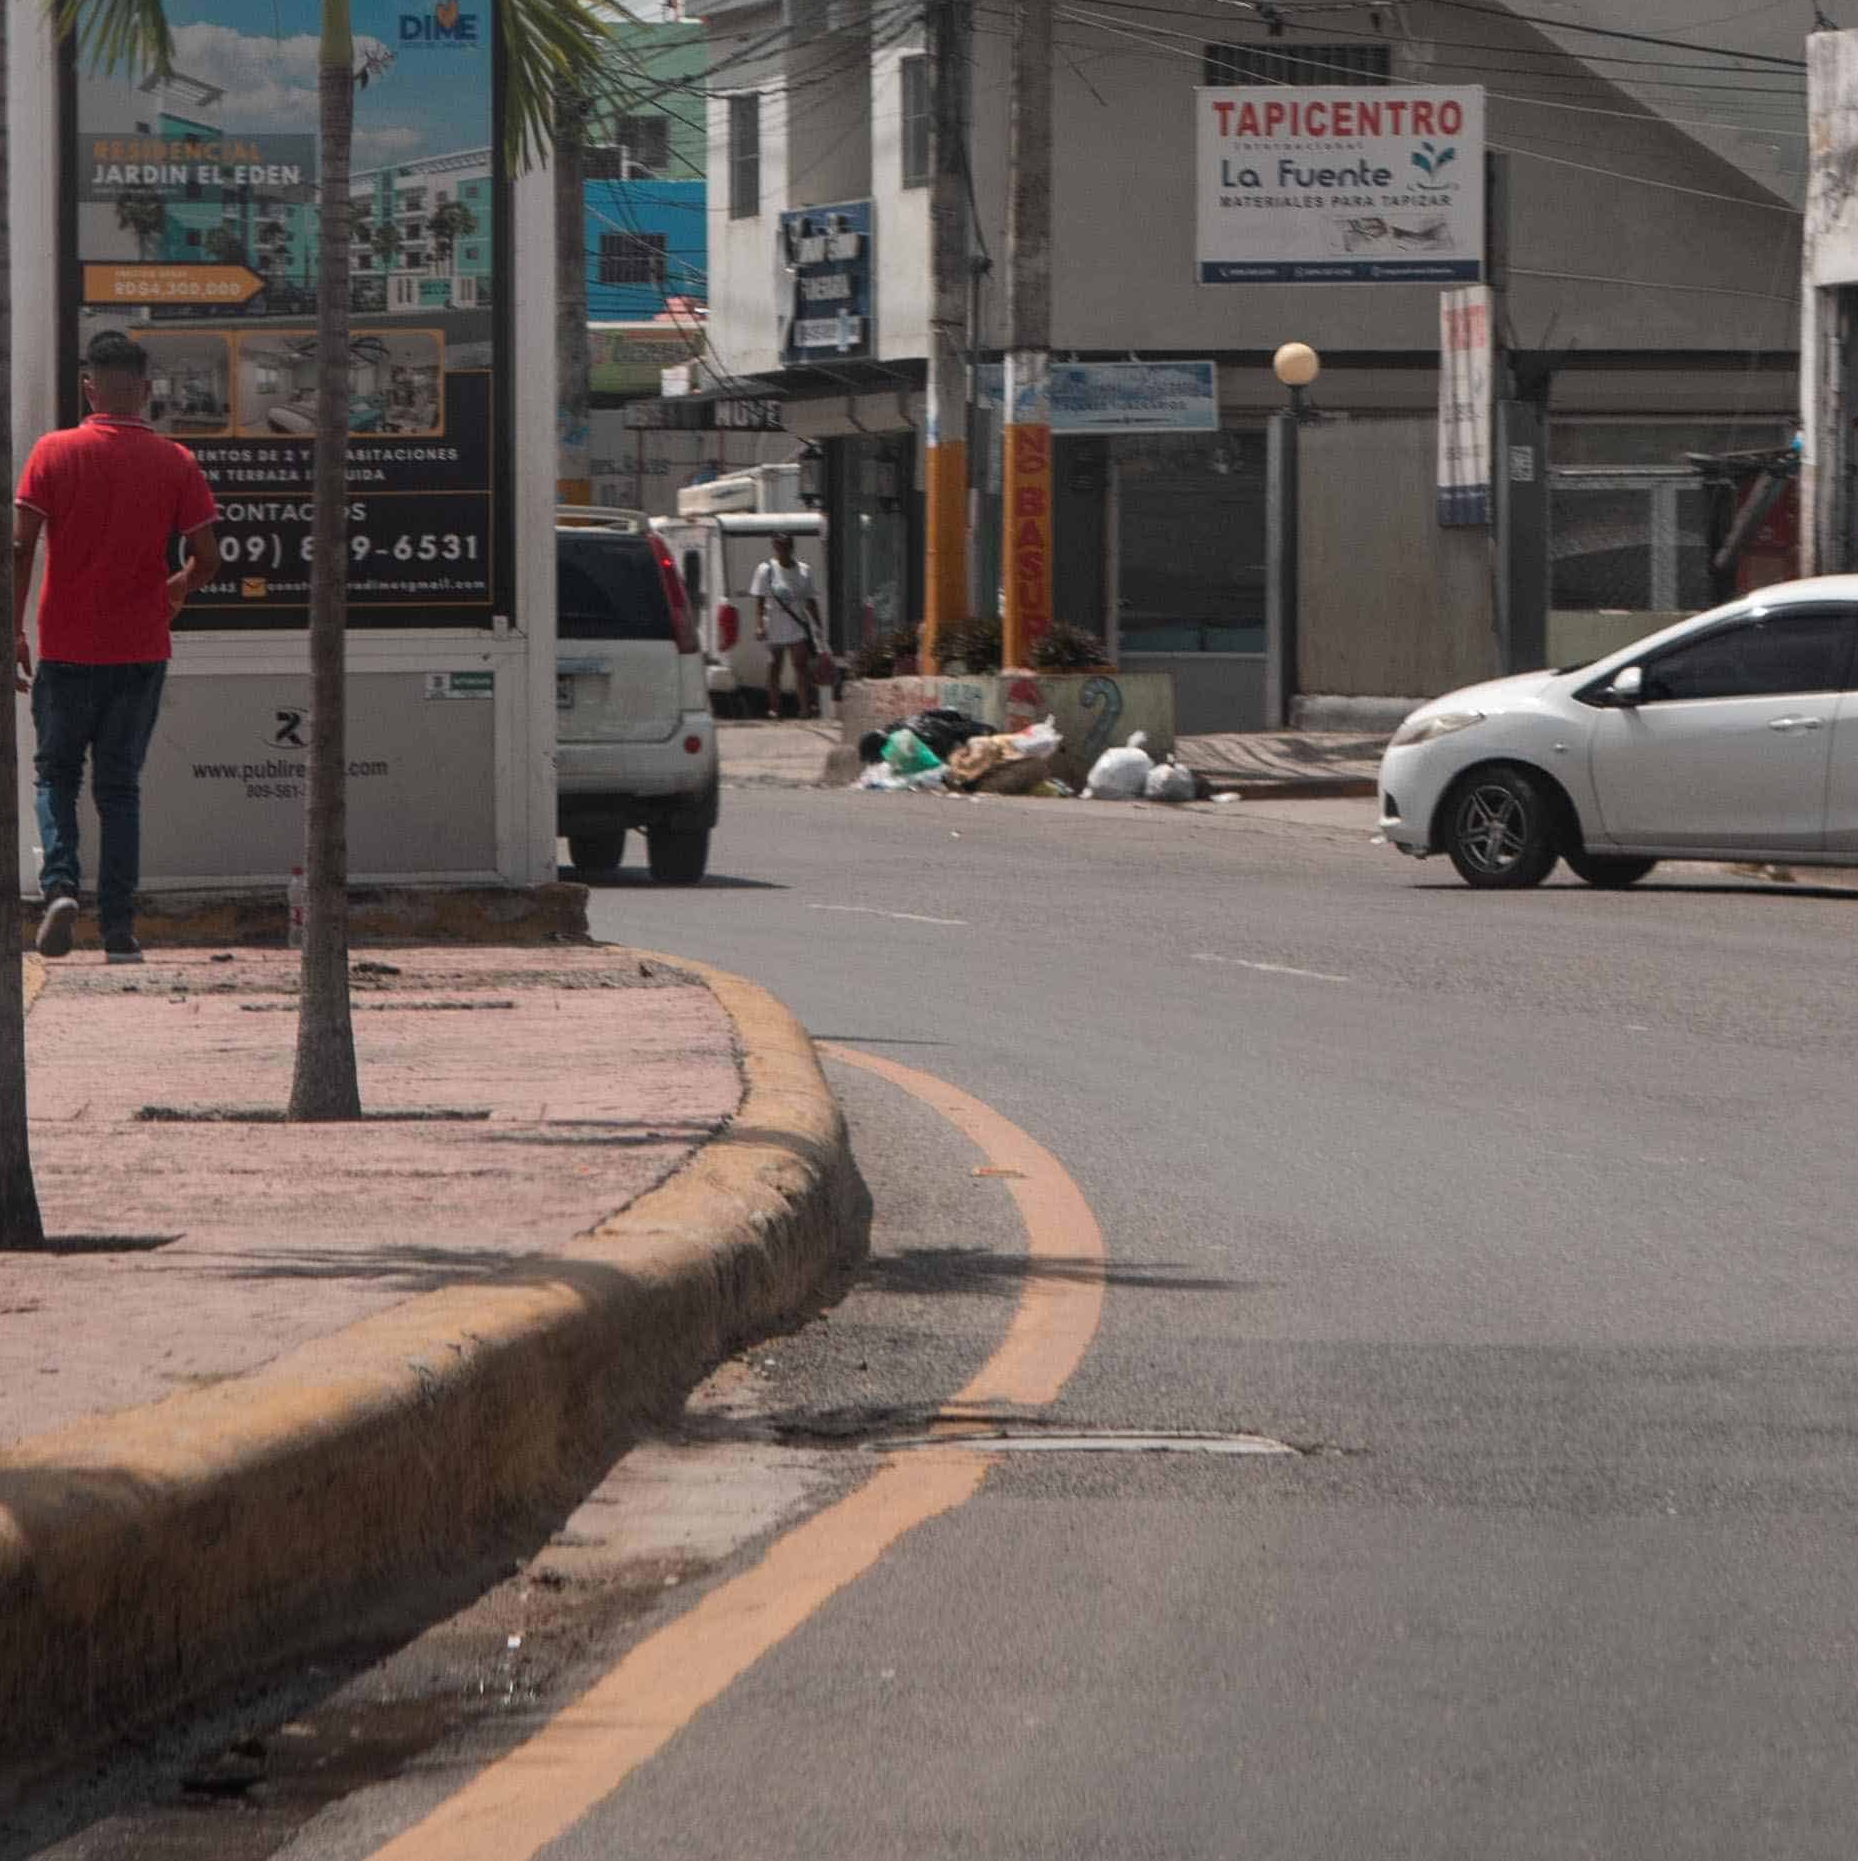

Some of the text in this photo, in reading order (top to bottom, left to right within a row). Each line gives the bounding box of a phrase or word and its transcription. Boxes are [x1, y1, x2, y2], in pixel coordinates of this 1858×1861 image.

[398, 12, 477, 41] DIME
[1212, 100, 1463, 137] TAPICENTRO
[92, 165, 301, 185] JARDIN EL EDEN
[1221, 158, 1392, 188] La Fuente
[1219, 195, 1453, 208] MATERIALES PARA TAPIZAR
[257, 449, 278, 461] DE
[226, 469, 300, 481] TERRAZA
